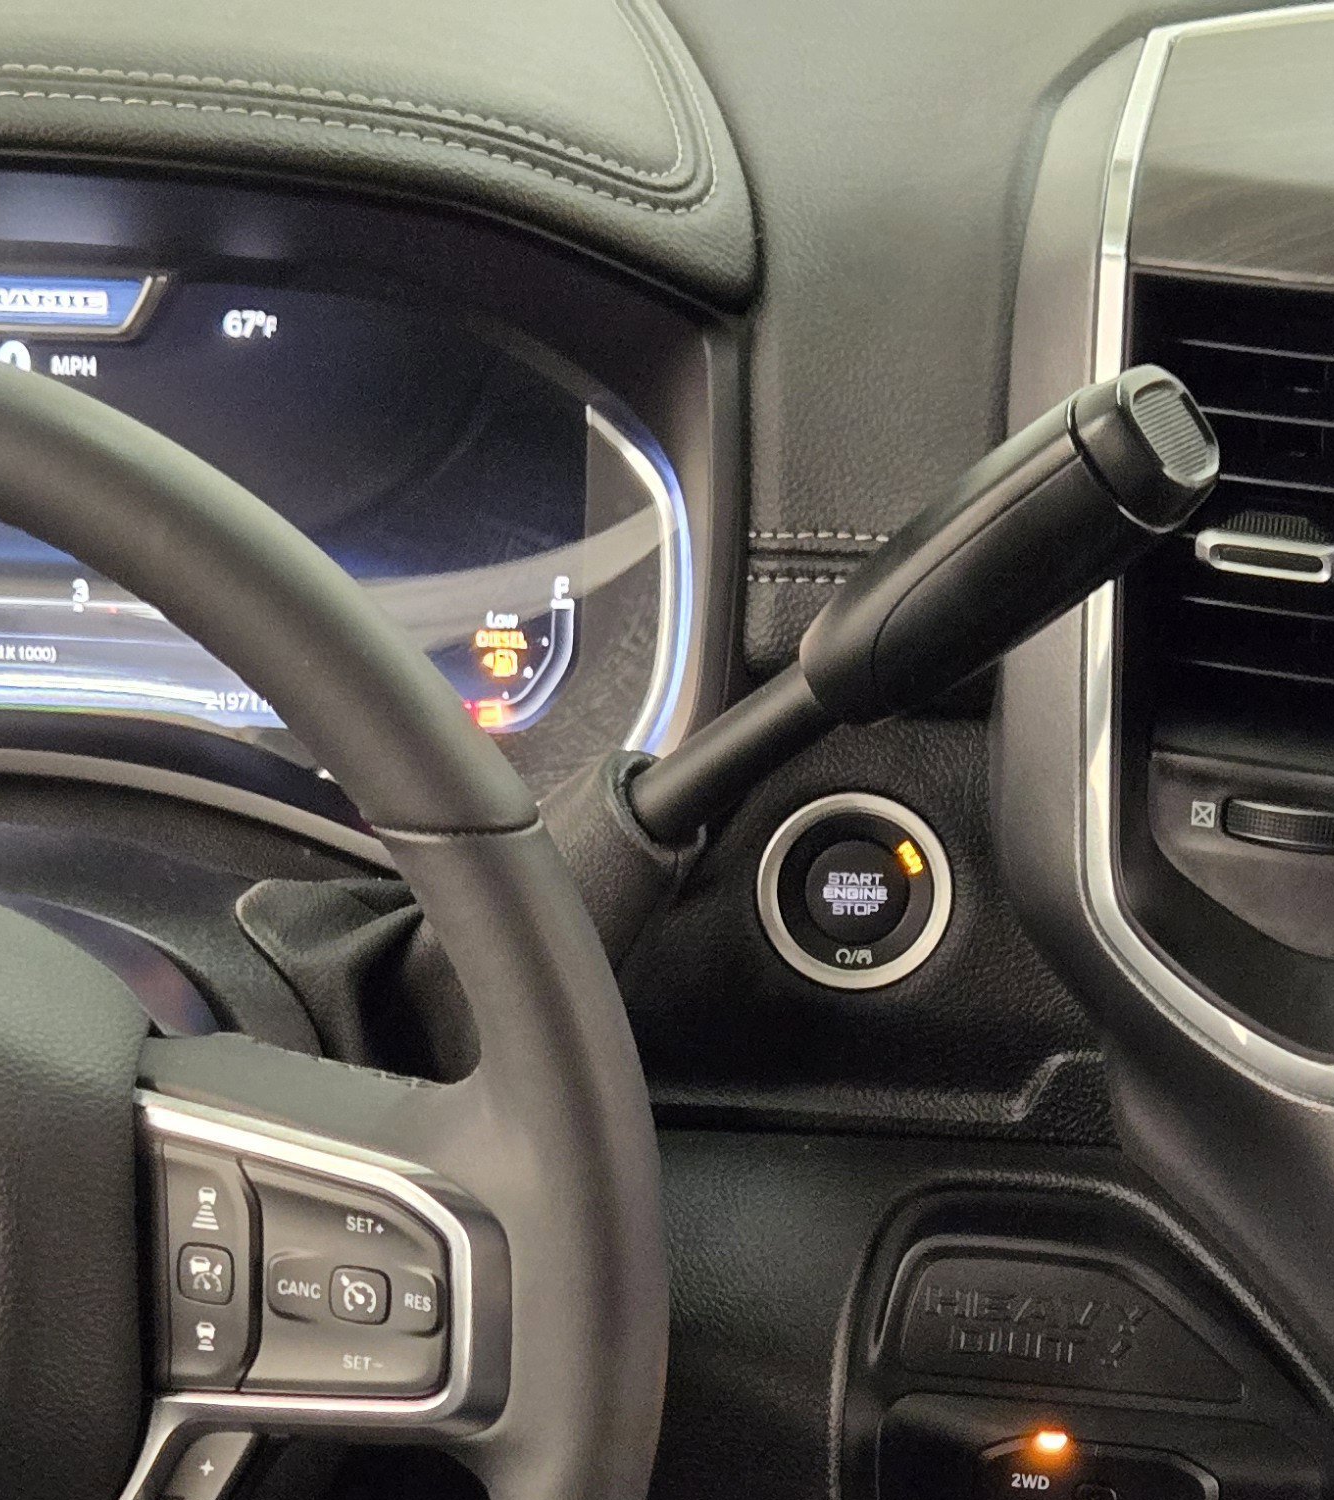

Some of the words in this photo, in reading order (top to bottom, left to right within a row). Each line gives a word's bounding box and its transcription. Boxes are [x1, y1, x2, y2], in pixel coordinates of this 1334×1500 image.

[51, 356, 97, 377] MPH
[72, 578, 90, 604] 3
[828, 872, 883, 886] START
[823, 886, 888, 901] ENGINE
[832, 904, 879, 916] STOP
[277, 1279, 322, 1299] CANC
[404, 1291, 432, 1312] RES
[1011, 1473, 1050, 1491] 2WD
